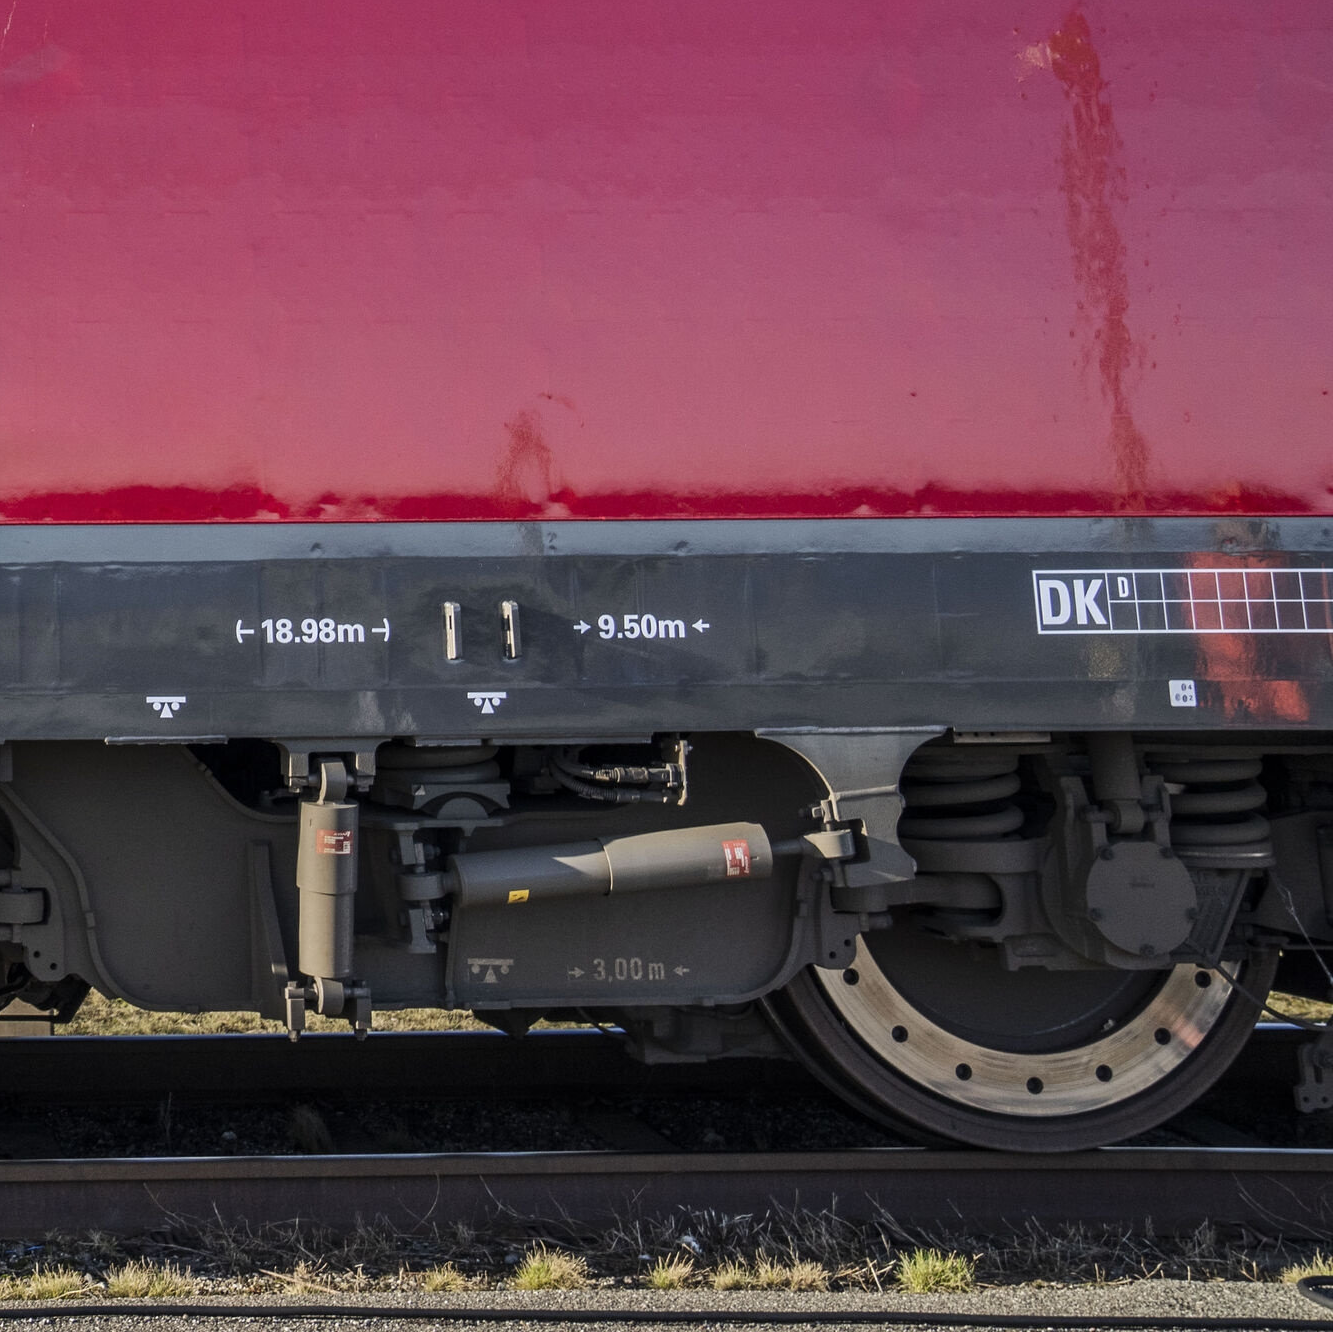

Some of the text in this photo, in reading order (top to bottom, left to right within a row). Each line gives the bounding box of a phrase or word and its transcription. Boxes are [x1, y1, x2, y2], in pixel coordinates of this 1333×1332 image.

[1038, 576, 1130, 625] DK D
[261, 618, 365, 644] 18.98m
[597, 614, 686, 640] 9.50m
